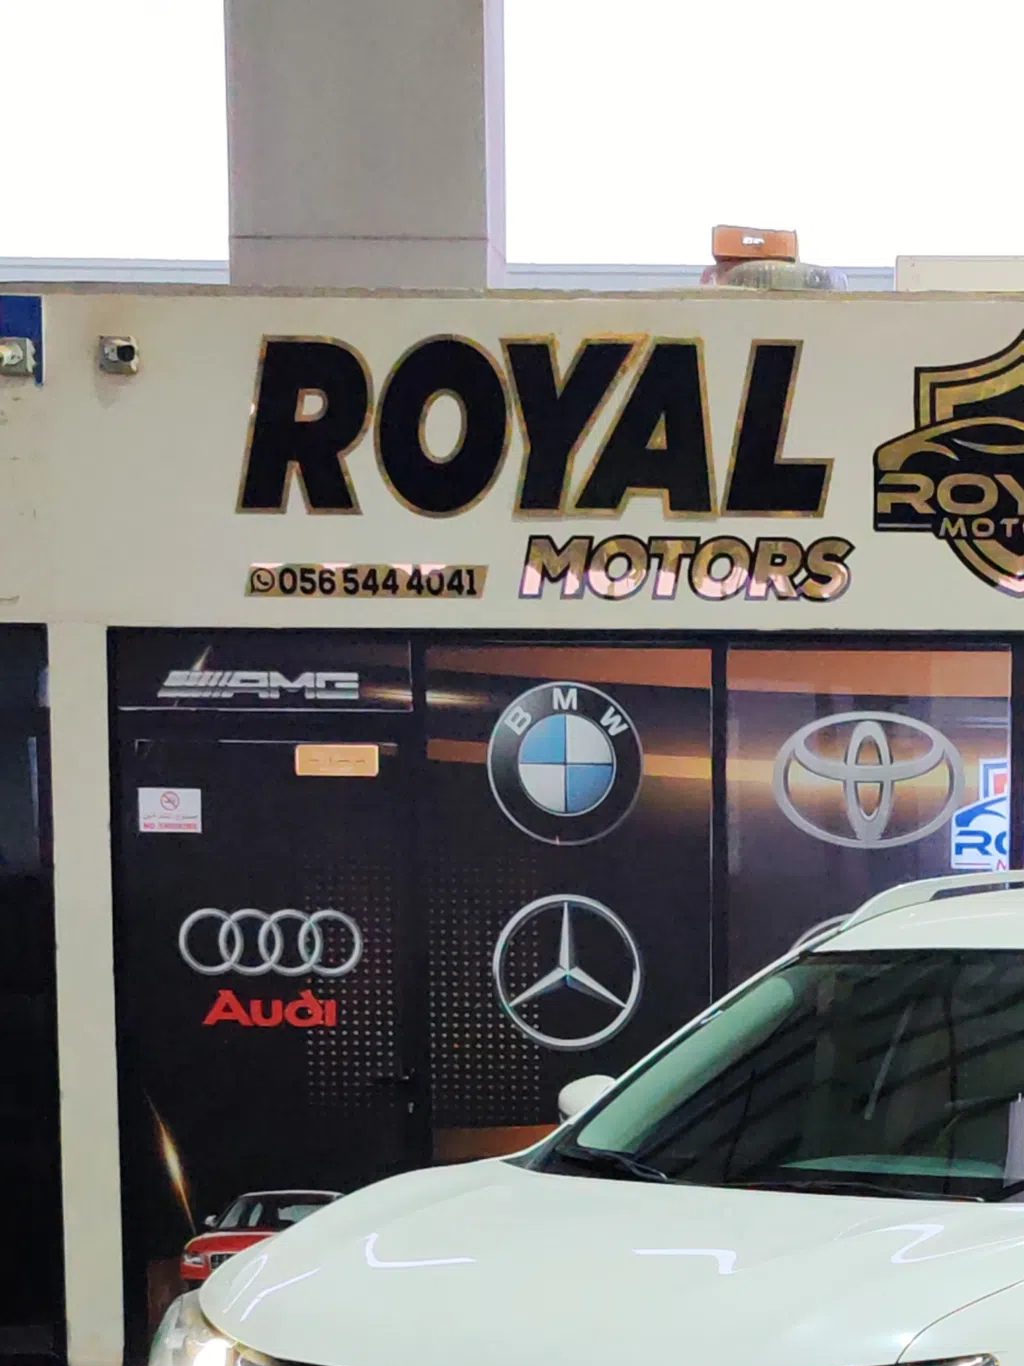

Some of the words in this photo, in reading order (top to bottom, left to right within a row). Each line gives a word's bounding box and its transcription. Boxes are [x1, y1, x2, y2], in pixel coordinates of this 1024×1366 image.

[235, 333, 835, 520] ROYAL
[279, 567, 335, 595] 056
[342, 567, 399, 595] 544
[405, 567, 477, 596] 4041
[518, 534, 856, 601] MOTORS
[503, 687, 630, 737] BMW
[202, 988, 337, 1027] Audi
